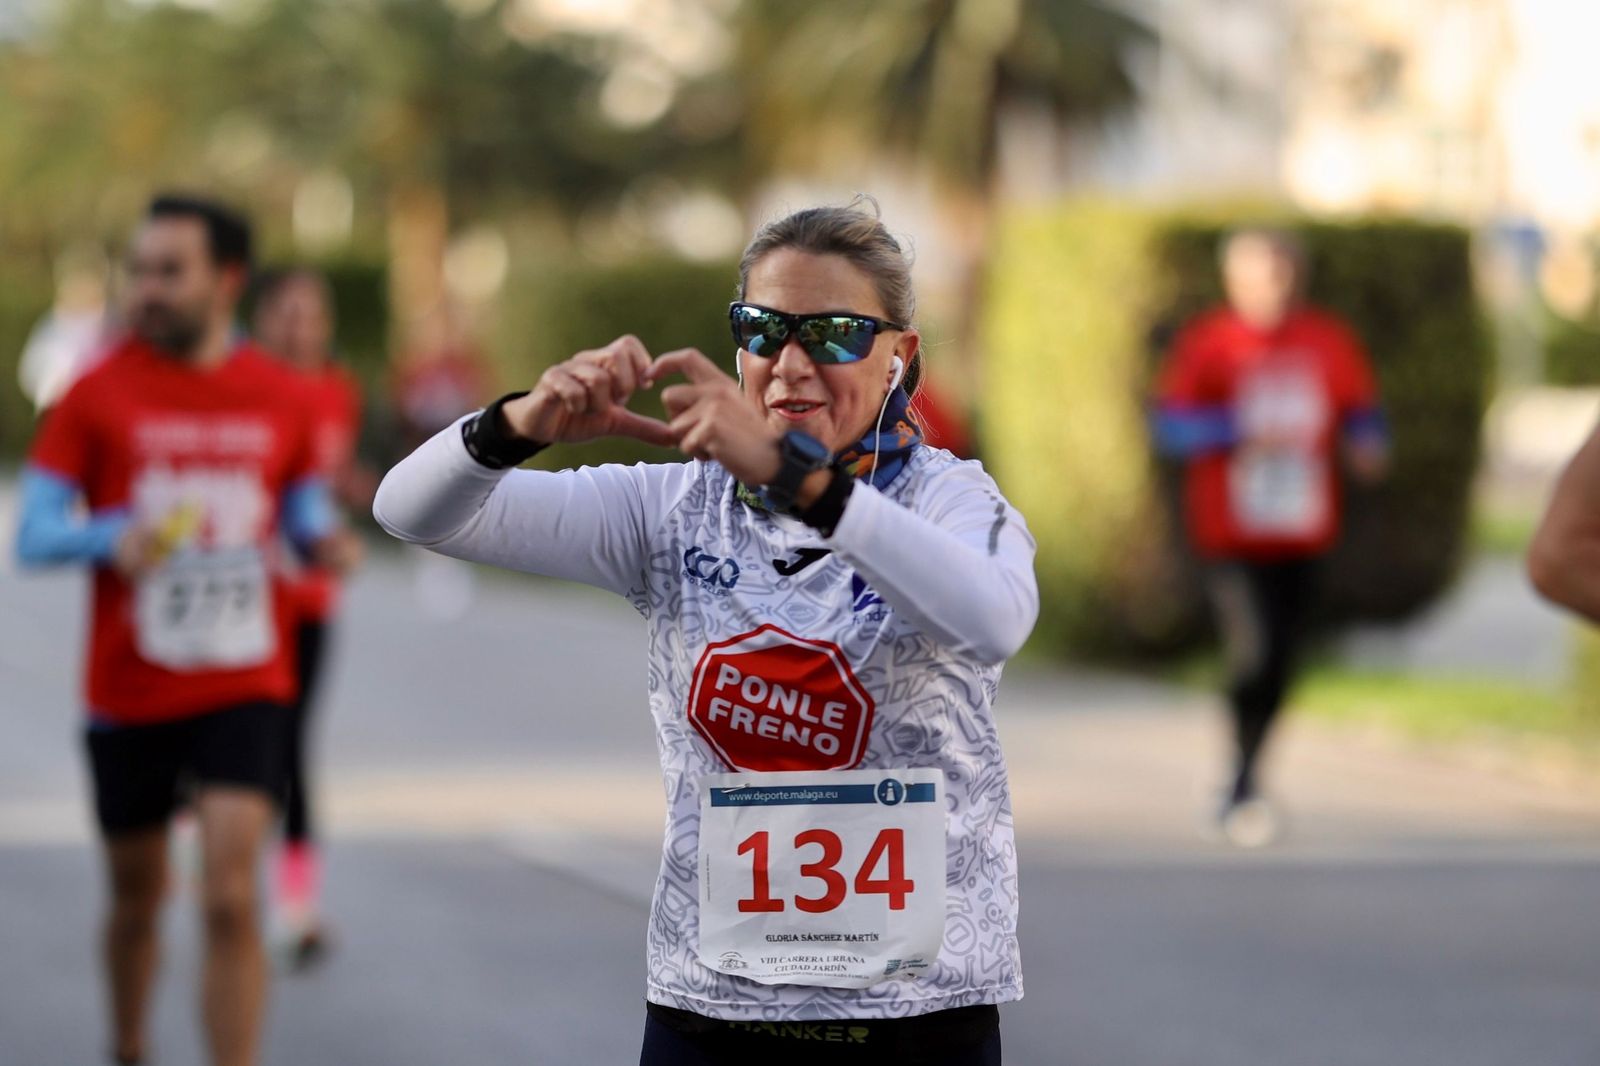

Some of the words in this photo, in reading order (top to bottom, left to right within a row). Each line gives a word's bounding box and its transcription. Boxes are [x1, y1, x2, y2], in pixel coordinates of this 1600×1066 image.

[715, 663, 848, 730] PONLE
[708, 697, 841, 756] FRENO
[728, 789, 839, 802] www.deporte.malaga.eu
[737, 828, 914, 913] 134
[765, 934, 800, 943] GLORIA
[801, 932, 842, 942] SÁNCHEZ
[844, 932, 880, 942] MARTÍN
[779, 955, 825, 964] CARRERA
[826, 955, 866, 964] URBANA
[774, 964, 811, 973] CIUDAD
[812, 963, 848, 972] JARDÍN
